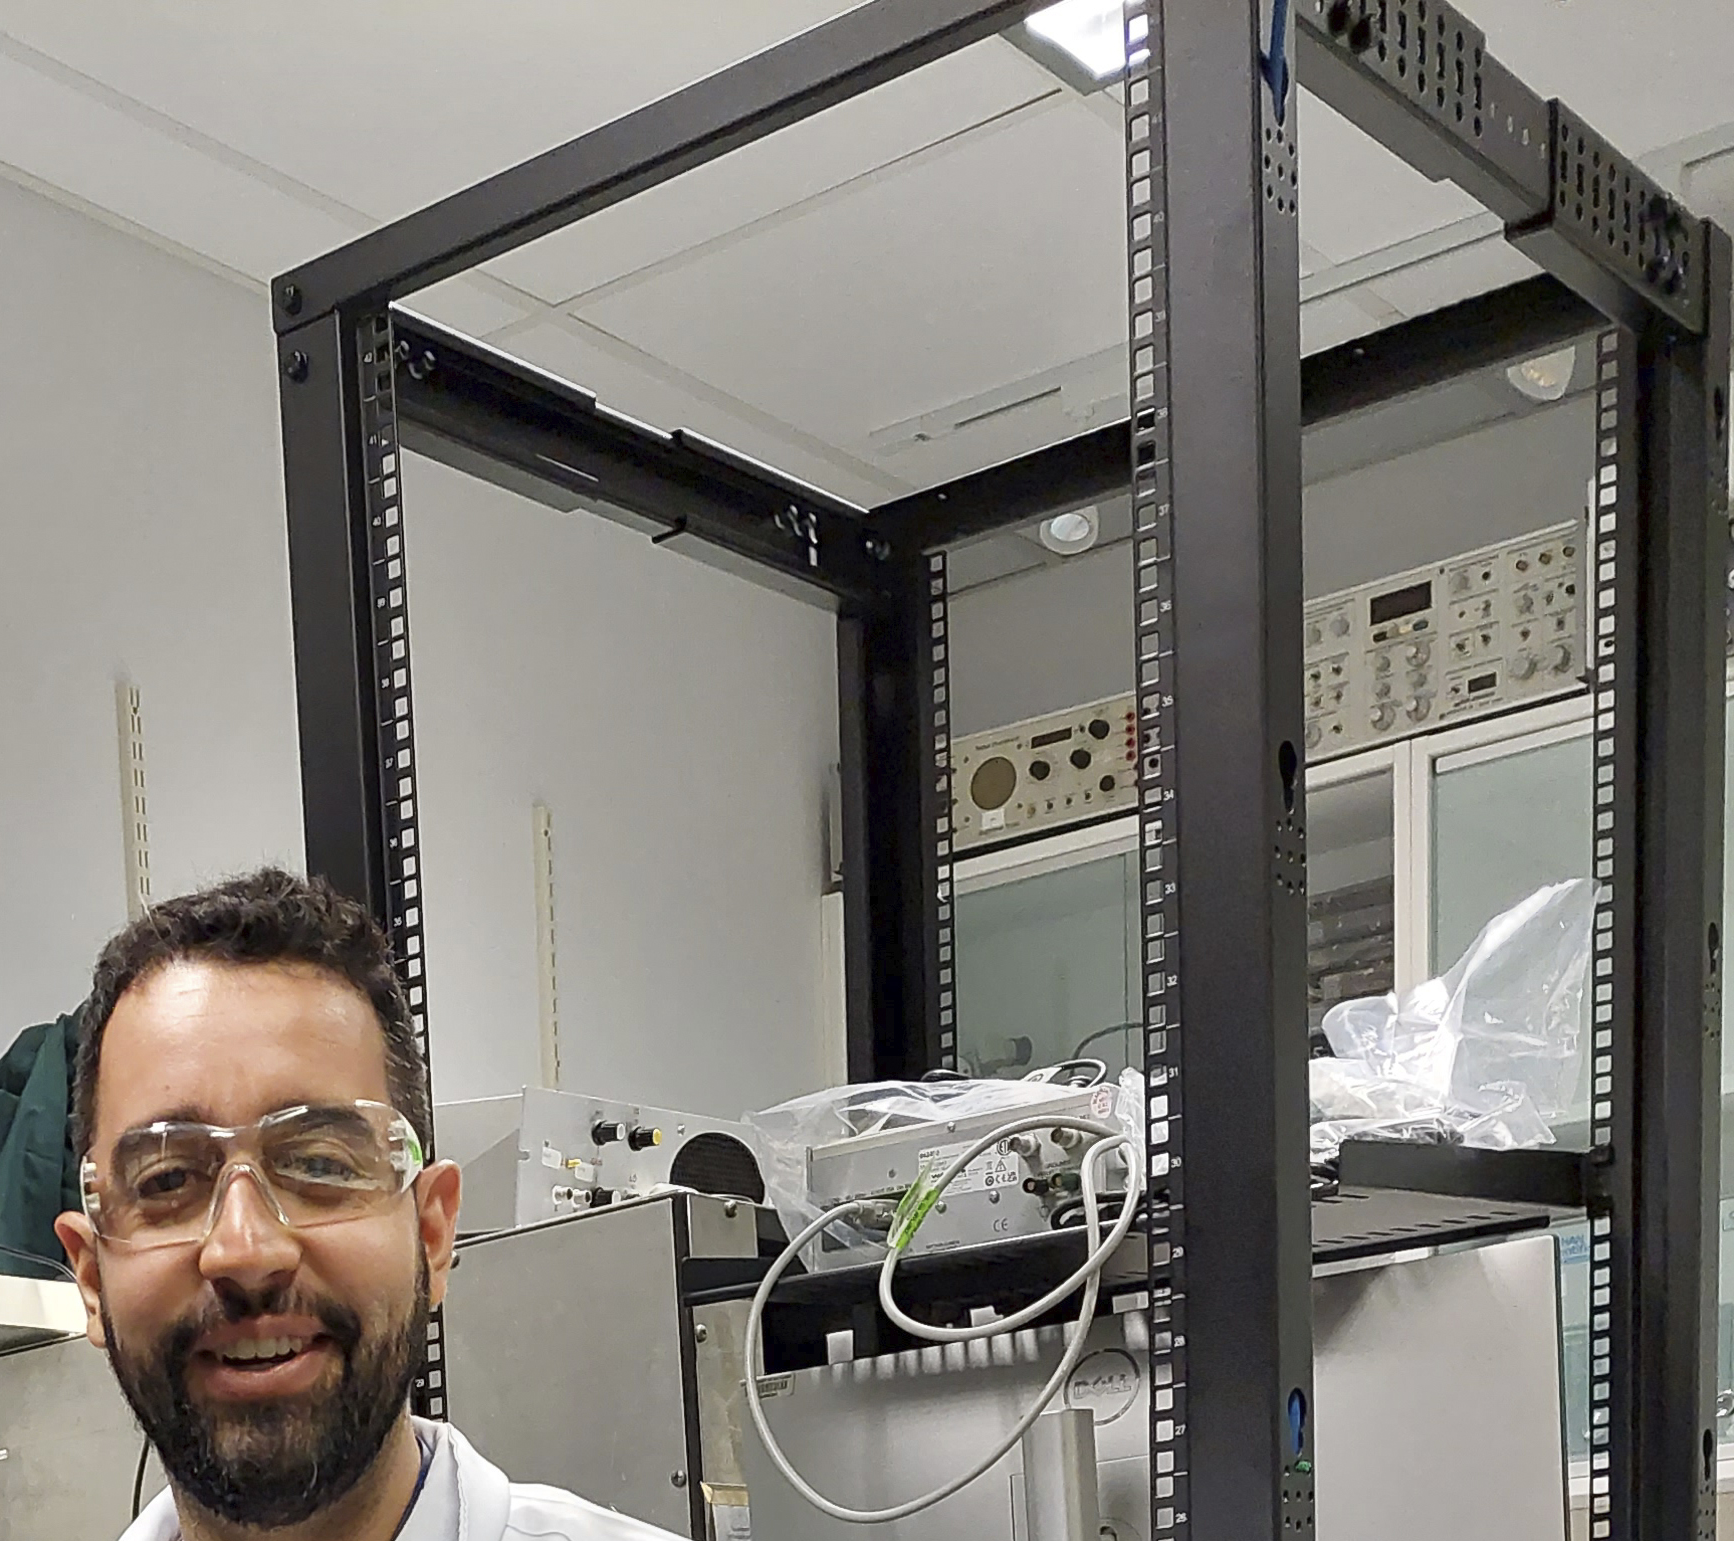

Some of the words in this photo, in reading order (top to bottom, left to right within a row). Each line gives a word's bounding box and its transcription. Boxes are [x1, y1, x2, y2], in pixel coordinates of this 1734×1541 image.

[1158, 504, 1170, 516] 37
[1163, 789, 1174, 801] 34
[1165, 883, 1176, 894] 33
[1166, 975, 1178, 986] 32
[1168, 1067, 1179, 1078] 31
[1171, 1156, 1182, 1168] 30
[1074, 1374, 1132, 1400] DELL
[1175, 1424, 1186, 1436] 27
